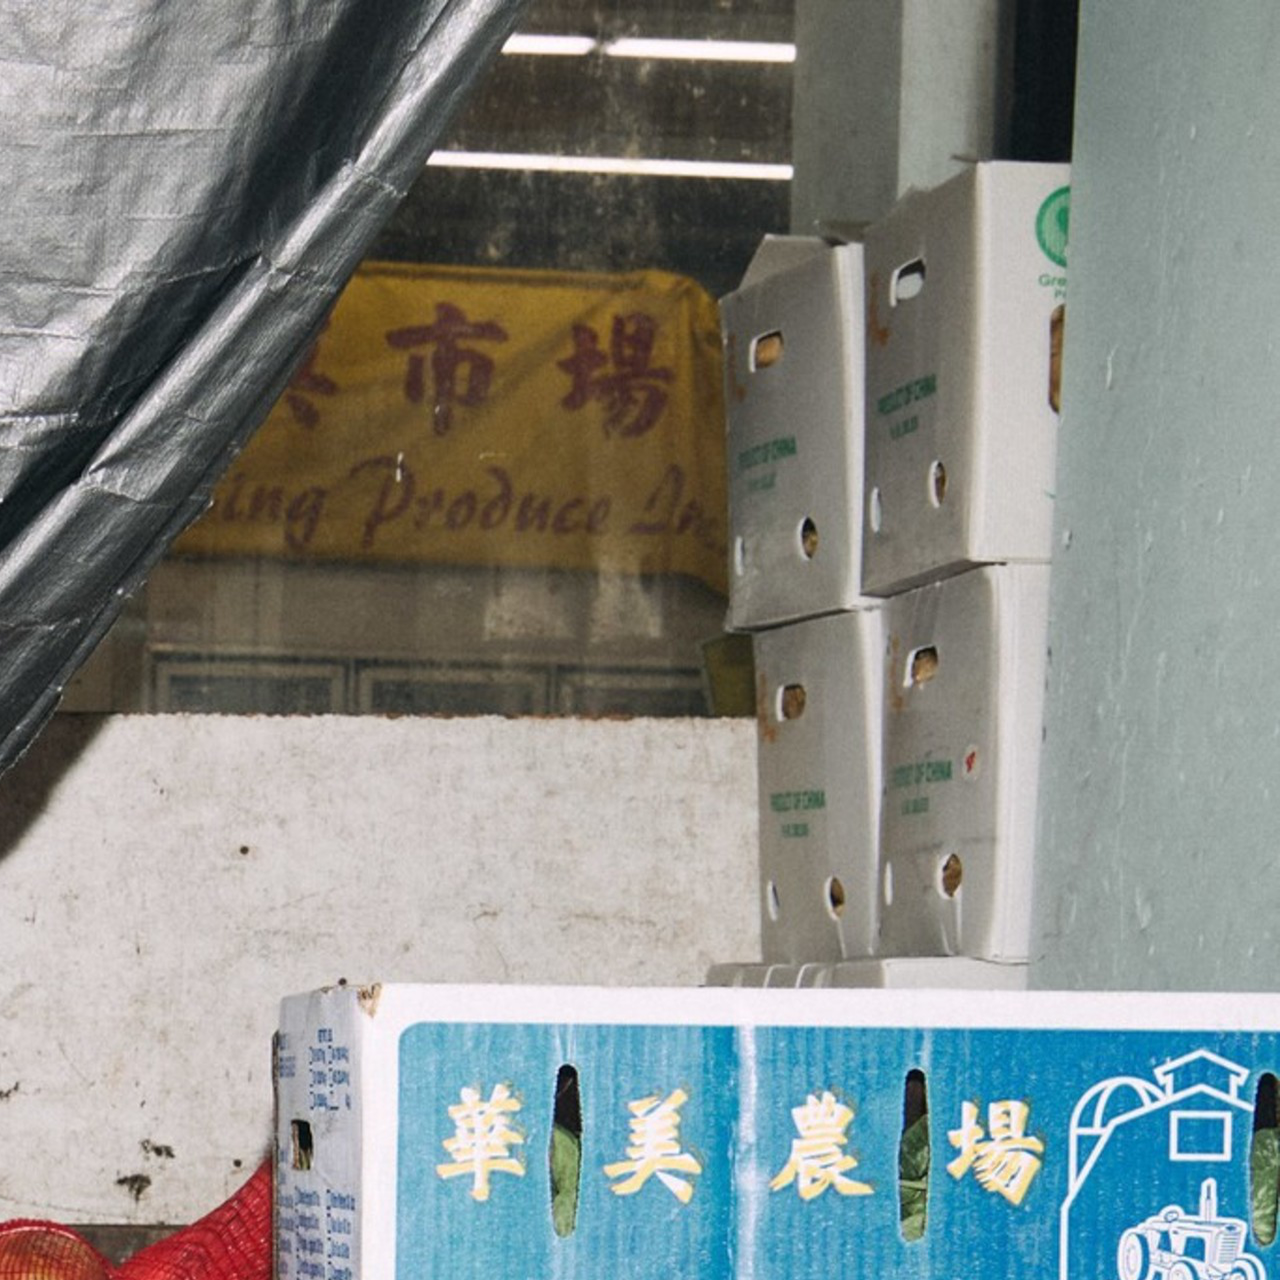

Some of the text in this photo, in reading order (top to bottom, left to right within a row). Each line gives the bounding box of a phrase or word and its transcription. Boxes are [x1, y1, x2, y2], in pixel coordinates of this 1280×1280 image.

[285, 304, 675, 431] 市場
[435, 1083, 1045, 1206] 華美農場
